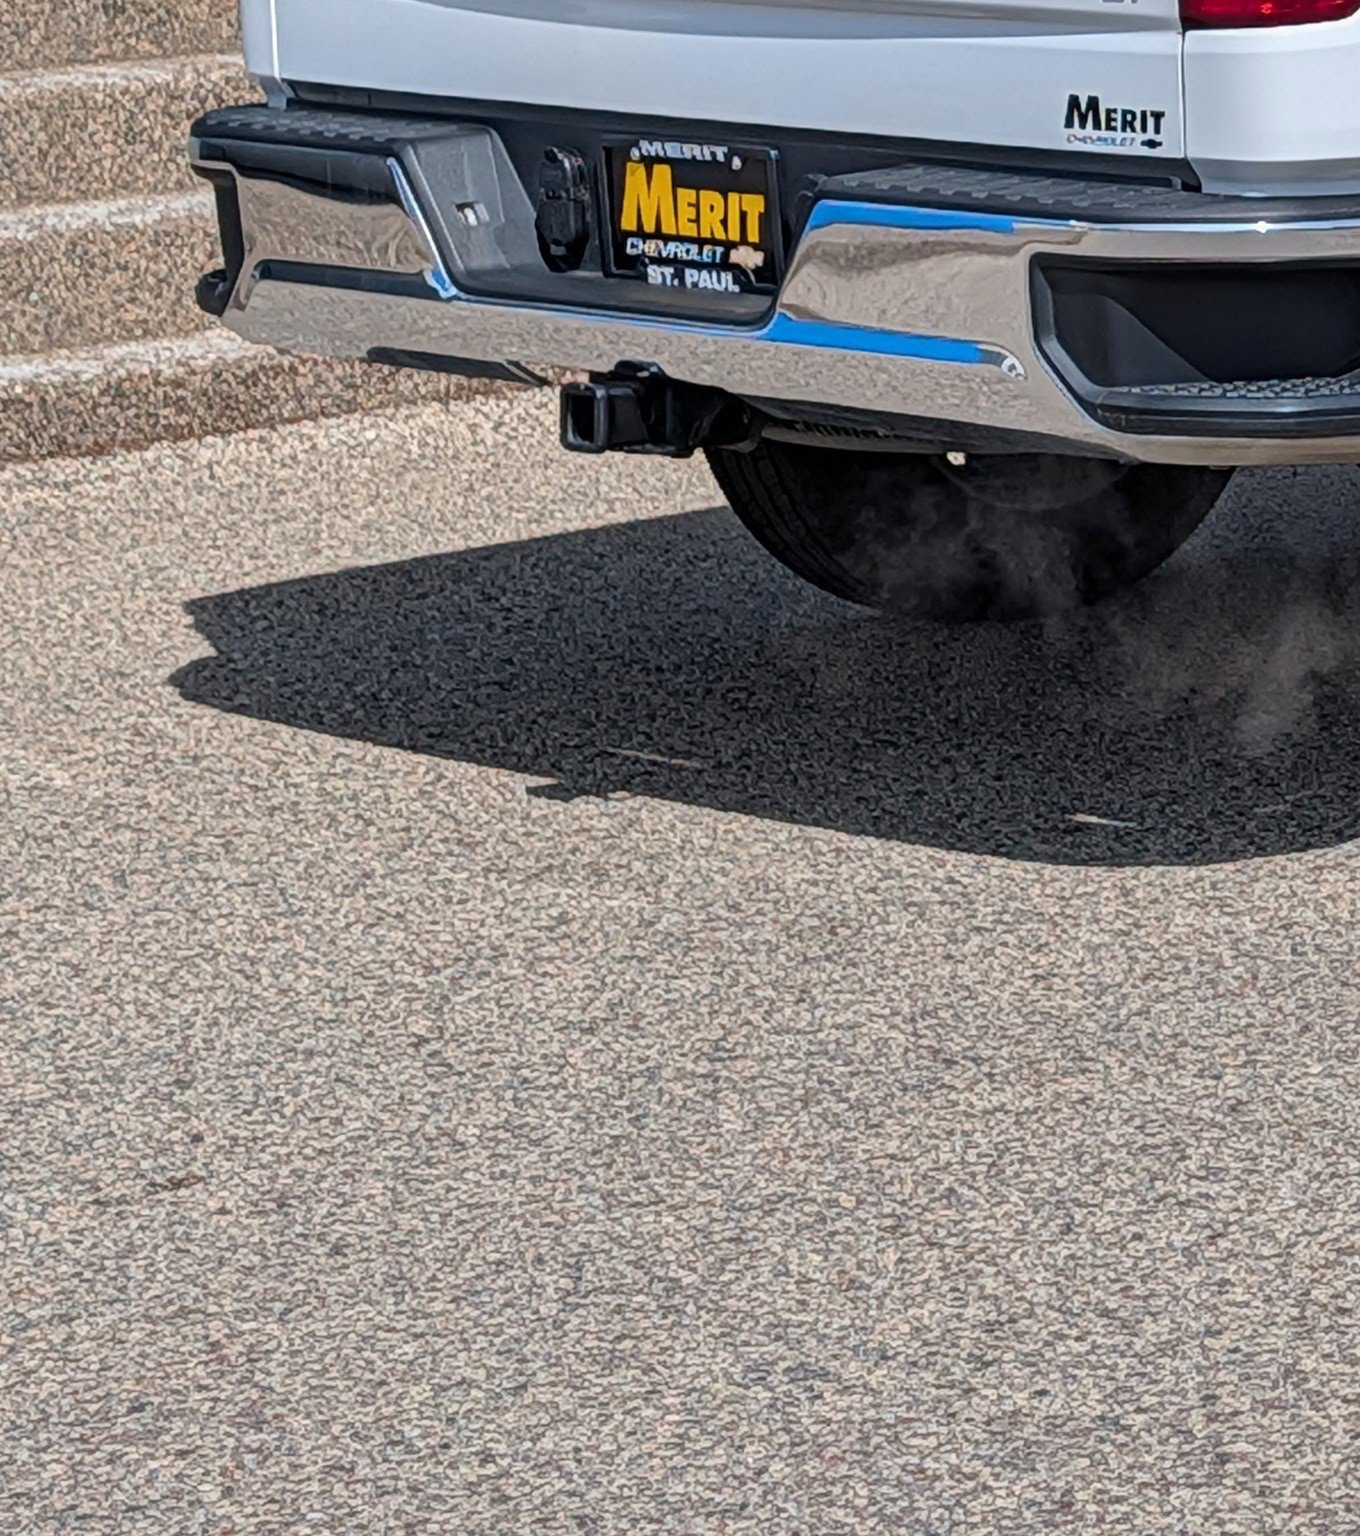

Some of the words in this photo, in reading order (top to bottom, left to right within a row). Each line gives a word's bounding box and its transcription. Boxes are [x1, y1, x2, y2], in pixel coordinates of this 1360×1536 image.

[1064, 93, 1166, 135] MERIT
[638, 139, 729, 163] MERIT
[620, 161, 765, 243] MERIT
[626, 236, 725, 263] CHEVROLET
[647, 264, 680, 287] ST.
[684, 267, 741, 294] PAUL
